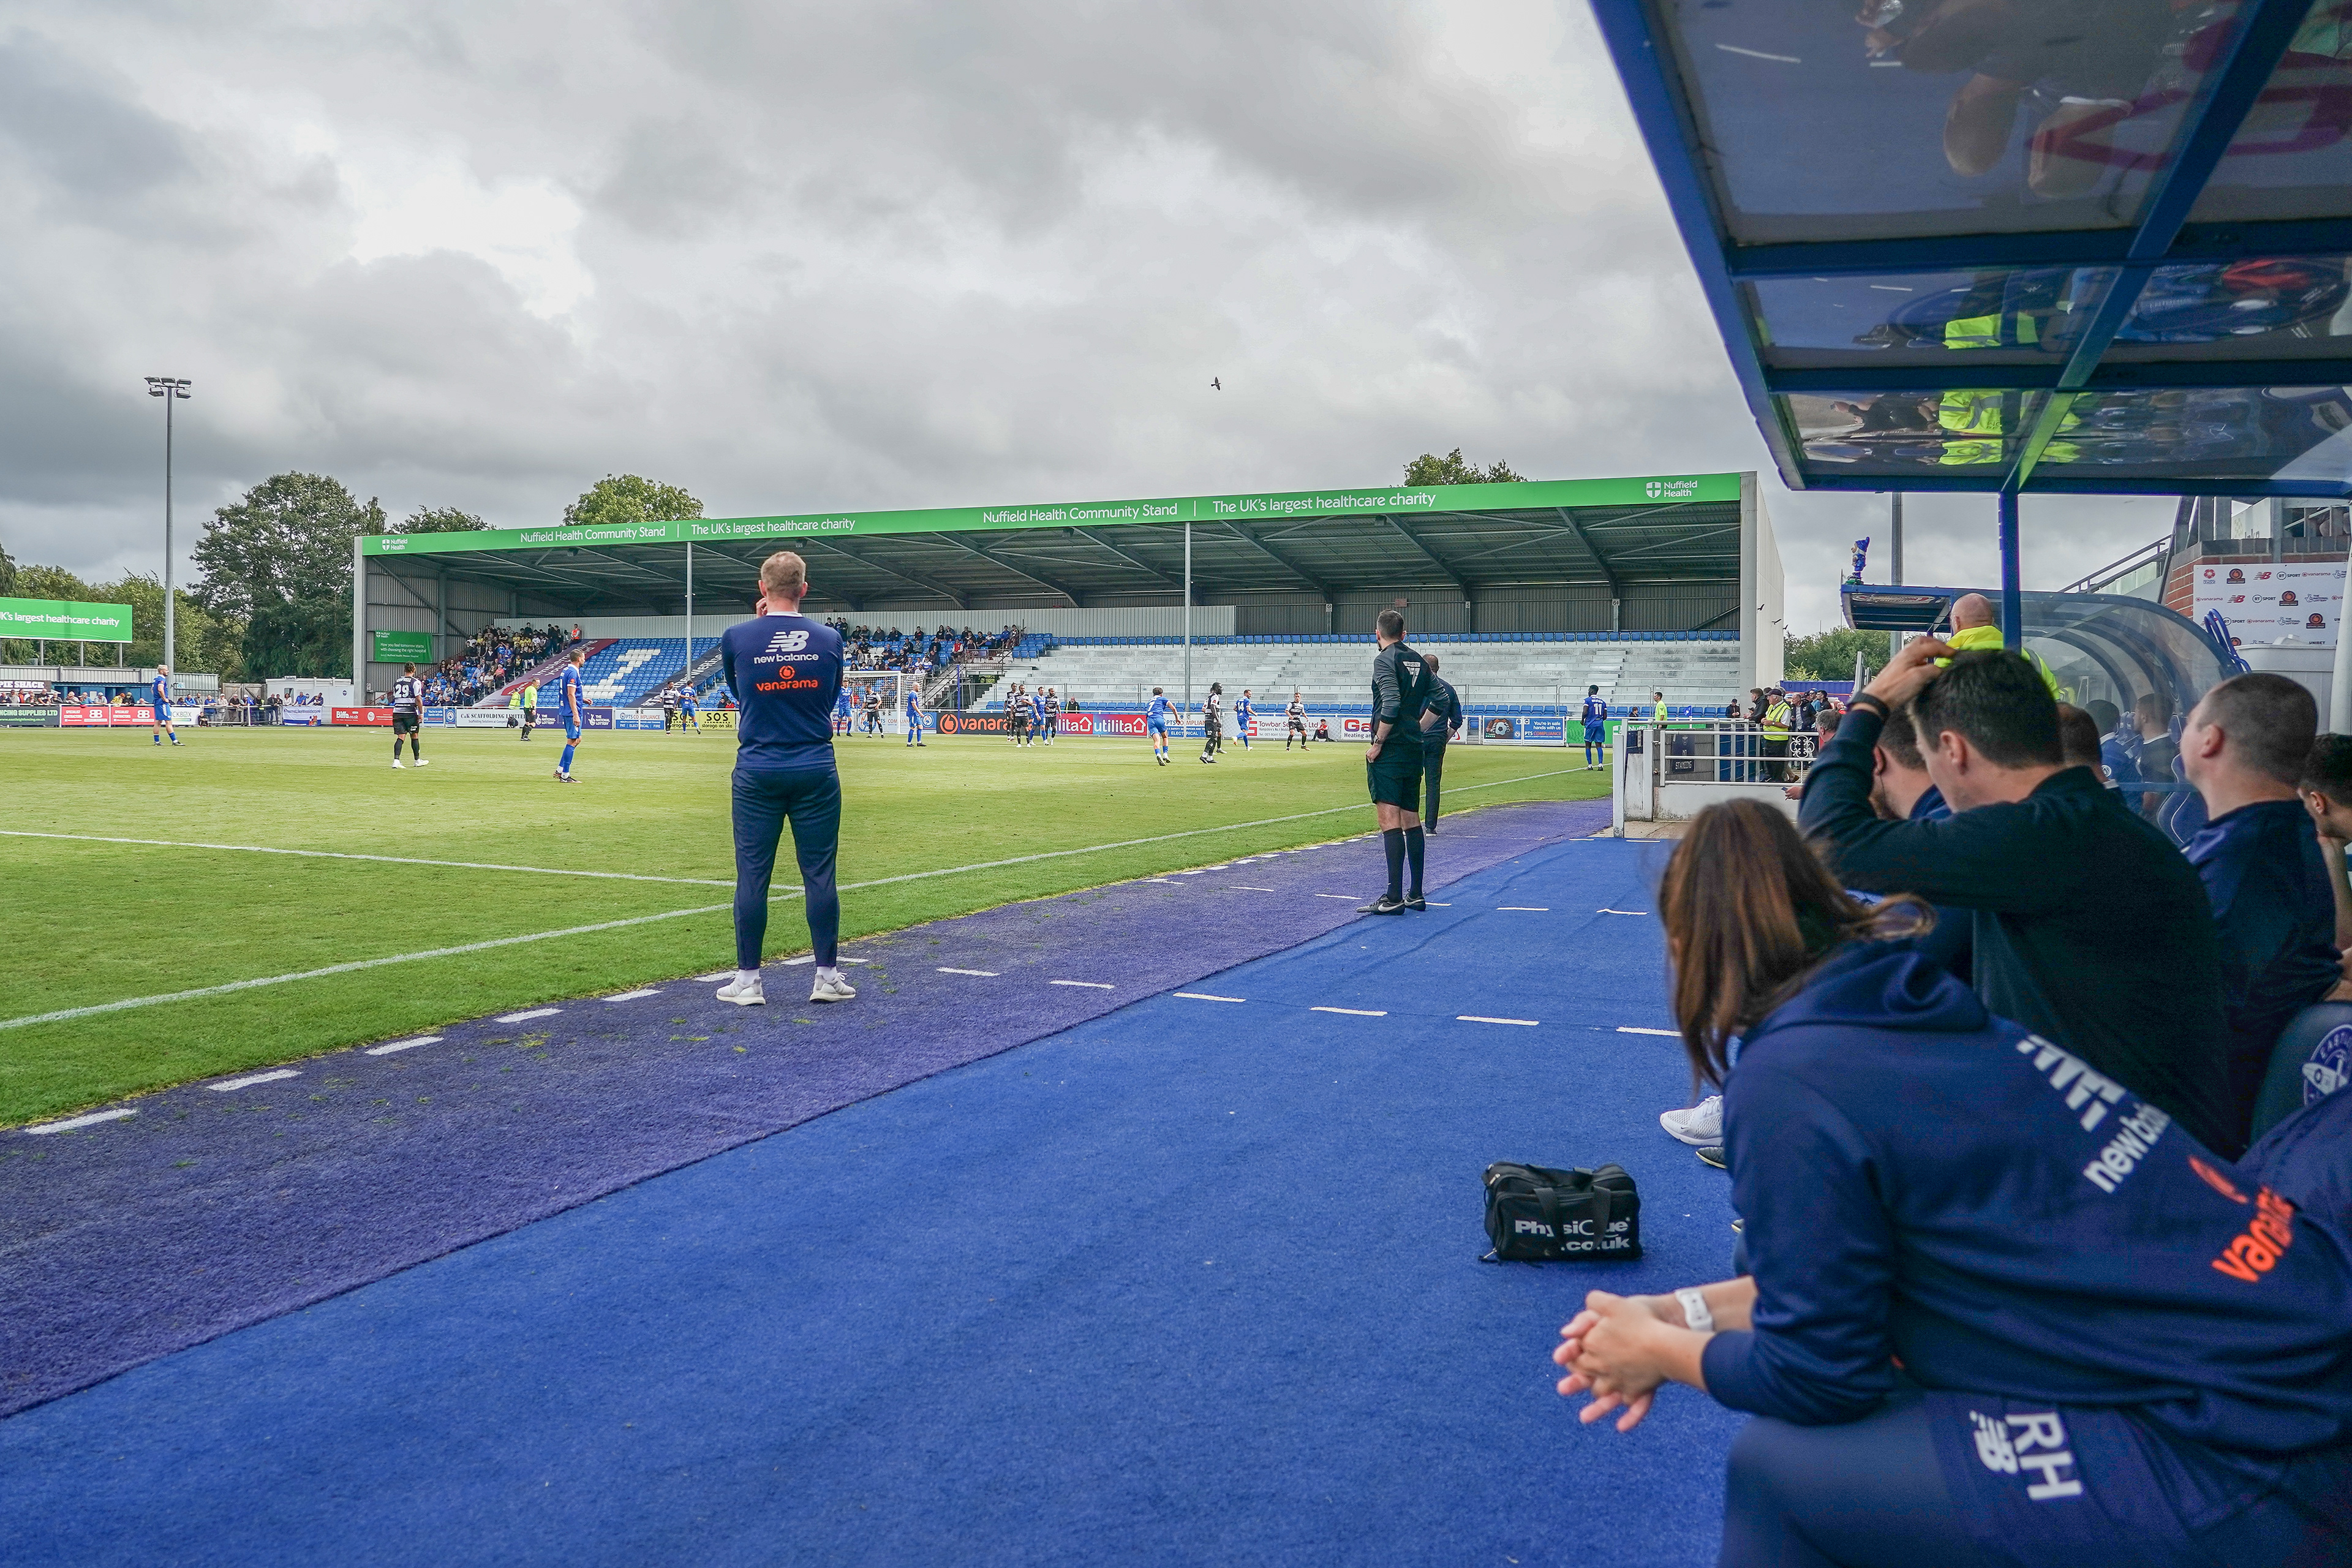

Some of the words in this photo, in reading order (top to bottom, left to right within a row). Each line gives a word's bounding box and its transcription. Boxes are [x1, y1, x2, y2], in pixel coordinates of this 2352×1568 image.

[1664, 480, 1698, 489] Nuffield
[1213, 500, 1236, 513] The
[1240, 499, 1267, 512] UK's
[1270, 497, 1312, 513] largest
[1316, 494, 1385, 510] healthcare
[1389, 491, 1436, 507] charity
[983, 510, 1027, 523] Nuffield
[1030, 508, 1066, 521] Health
[1069, 505, 1139, 520] Community
[1142, 503, 1178, 516] Stand
[691, 524, 709, 535] The
[711, 522, 731, 533] UK's
[733, 522, 764, 536] largest
[767, 520, 819, 532] healthcare
[821, 518, 855, 530] charity
[521, 532, 553, 543] Nuffield
[556, 530, 582, 541] Health
[585, 527, 638, 540] Community
[639, 526, 665, 538] Stand
[15, 612, 45, 624] largest
[46, 614, 90, 624] healthcare
[92, 616, 119, 627] charity
[776, 653, 819, 662] balance
[395, 684, 409, 698] 29
[756, 679, 818, 692] vanarama
[1237, 702, 1245, 711] 14
[1593, 703, 1602, 715] 11
[1094, 719, 1133, 733] utilita
[1561, 1237, 1629, 1251] .co.uk
[2005, 1412, 2083, 1501] RH
